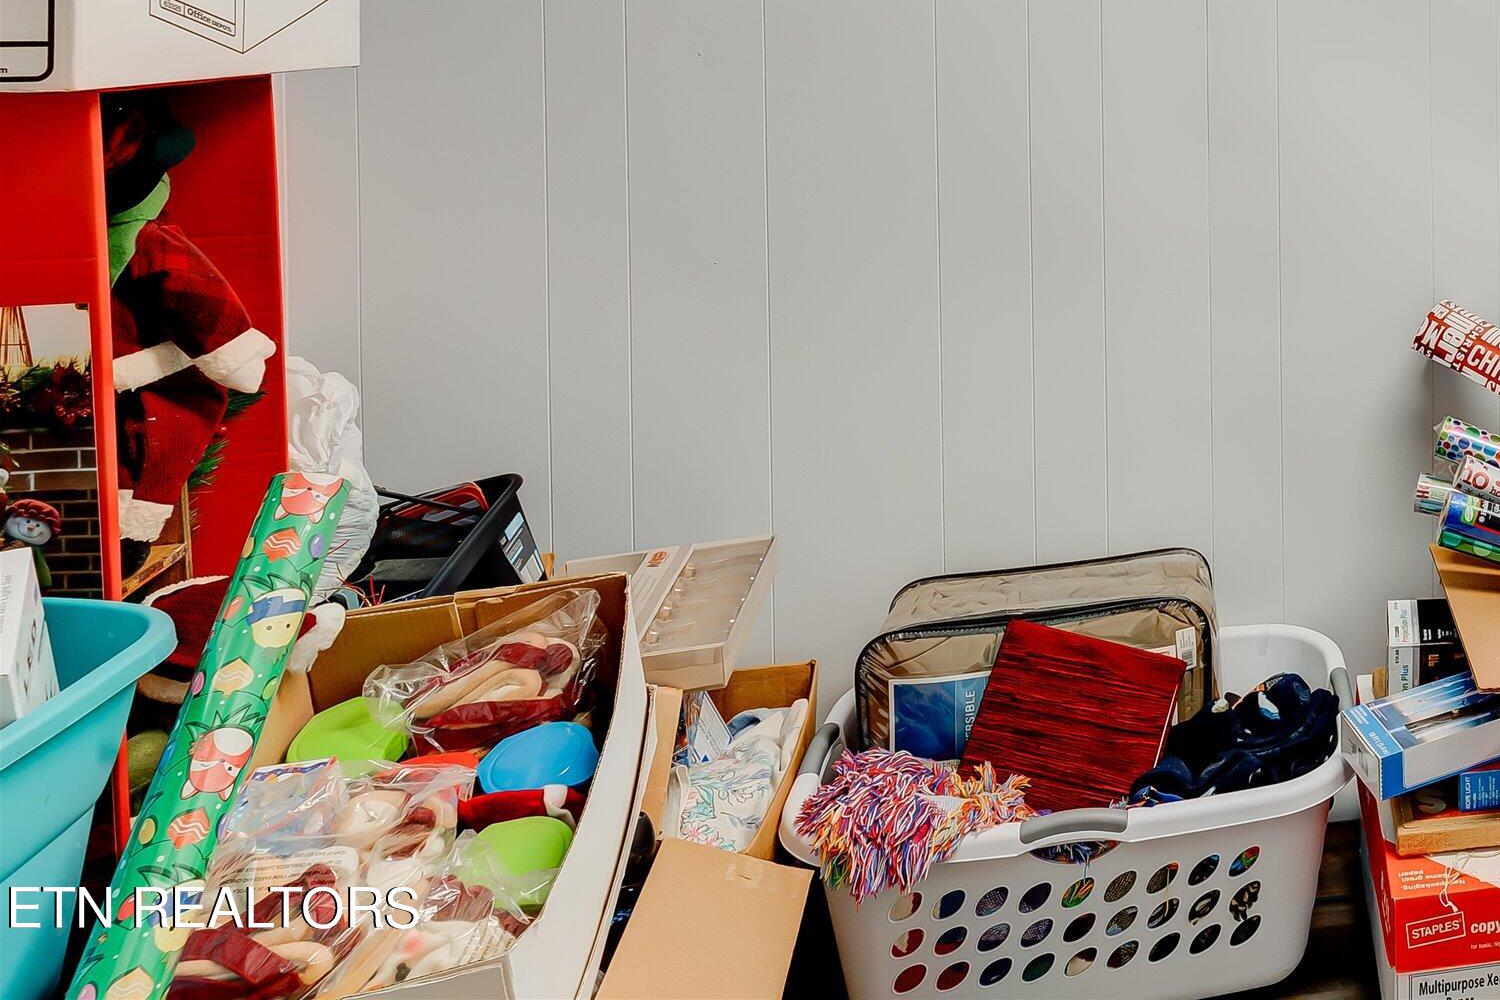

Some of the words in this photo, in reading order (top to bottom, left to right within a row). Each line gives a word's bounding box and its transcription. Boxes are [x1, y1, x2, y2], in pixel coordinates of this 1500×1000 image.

[187, 7, 211, 24] Office
[1400, 664, 1409, 682] Plus
[1411, 920, 1460, 940] STAPLES
[1418, 976, 1485, 997] Multipurpose
